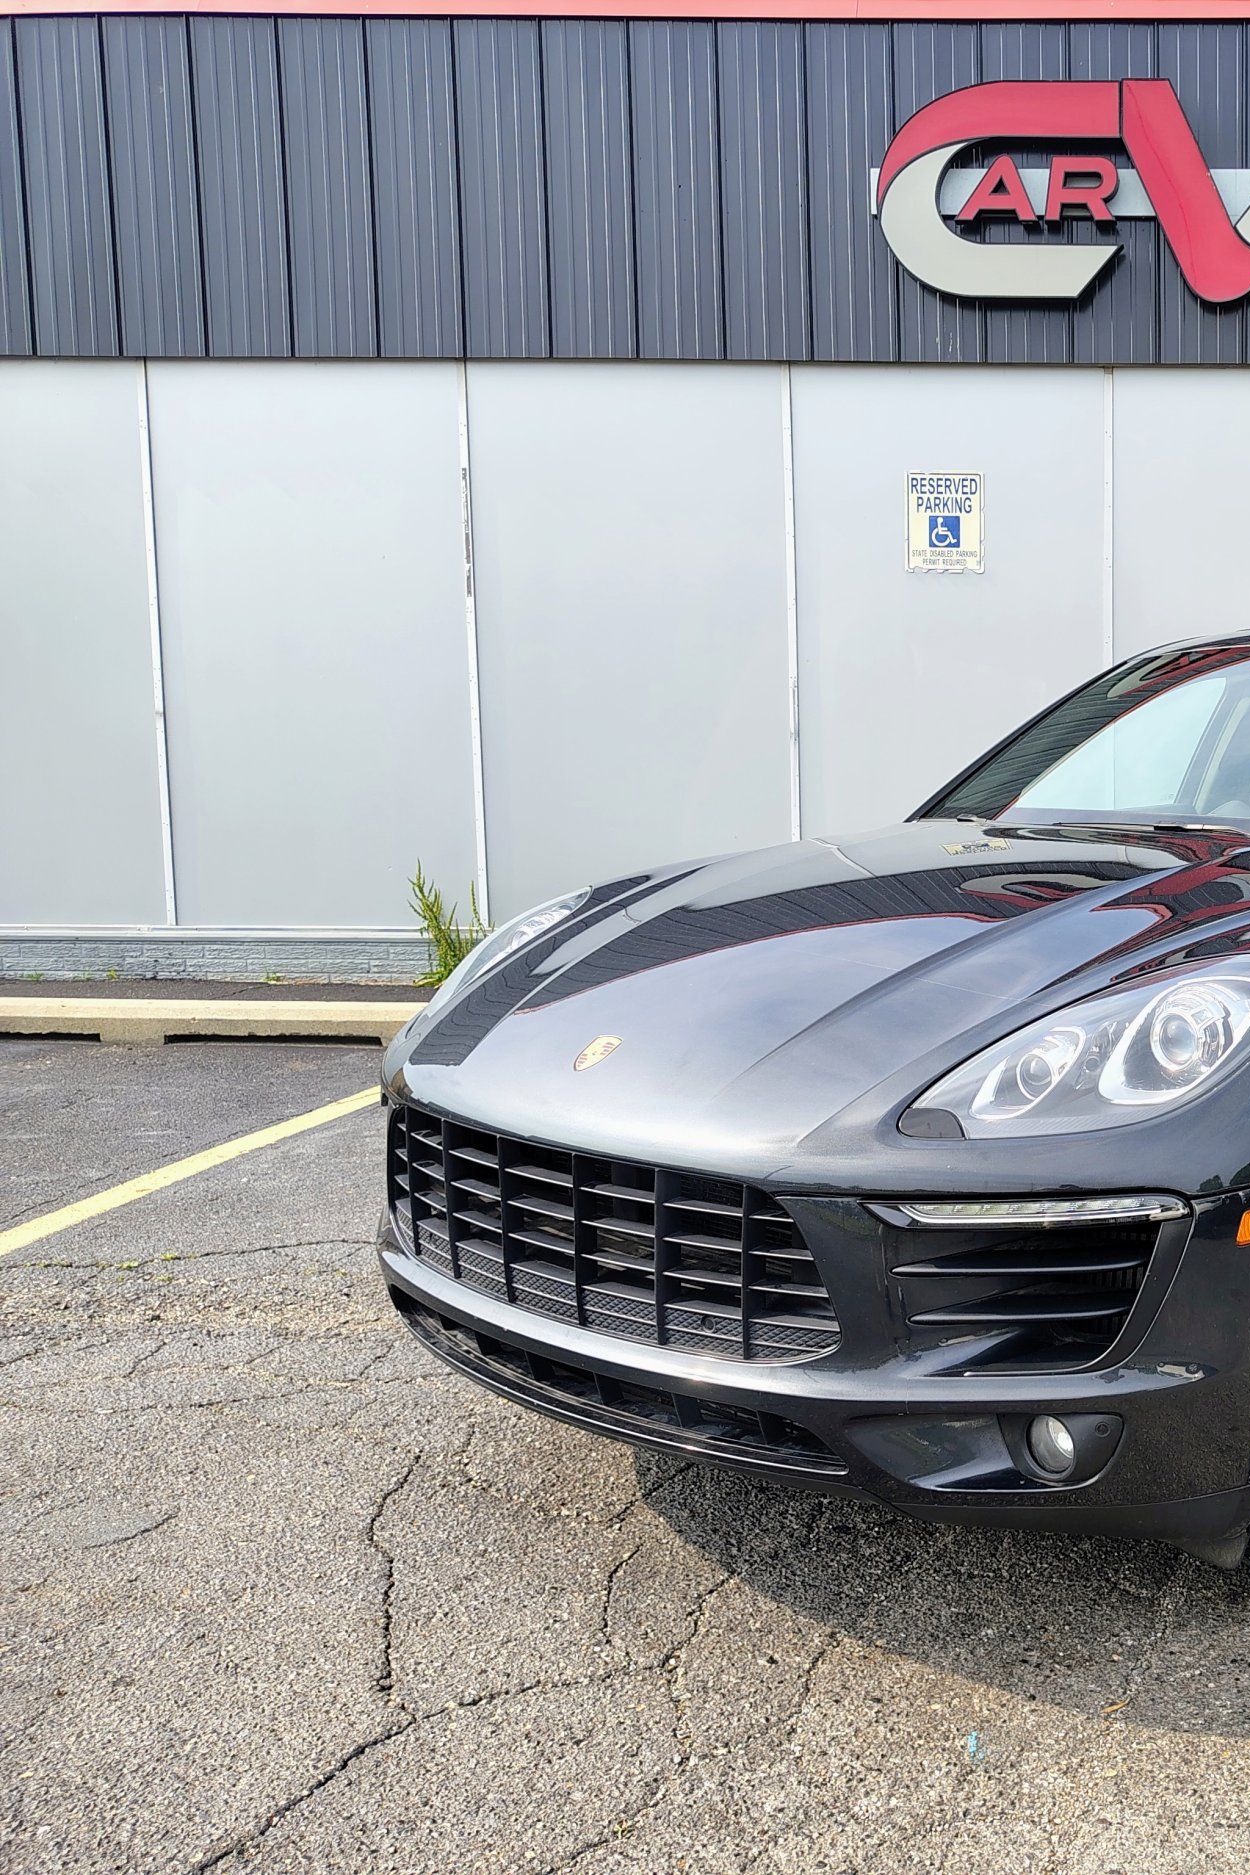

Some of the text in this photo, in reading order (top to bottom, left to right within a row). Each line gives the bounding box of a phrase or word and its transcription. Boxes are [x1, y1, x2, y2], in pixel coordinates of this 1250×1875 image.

[910, 477, 978, 495] RESERVED
[916, 496, 973, 514] PARKING
[956, 550, 978, 558] PARKING
[922, 558, 940, 566] PERMIT
